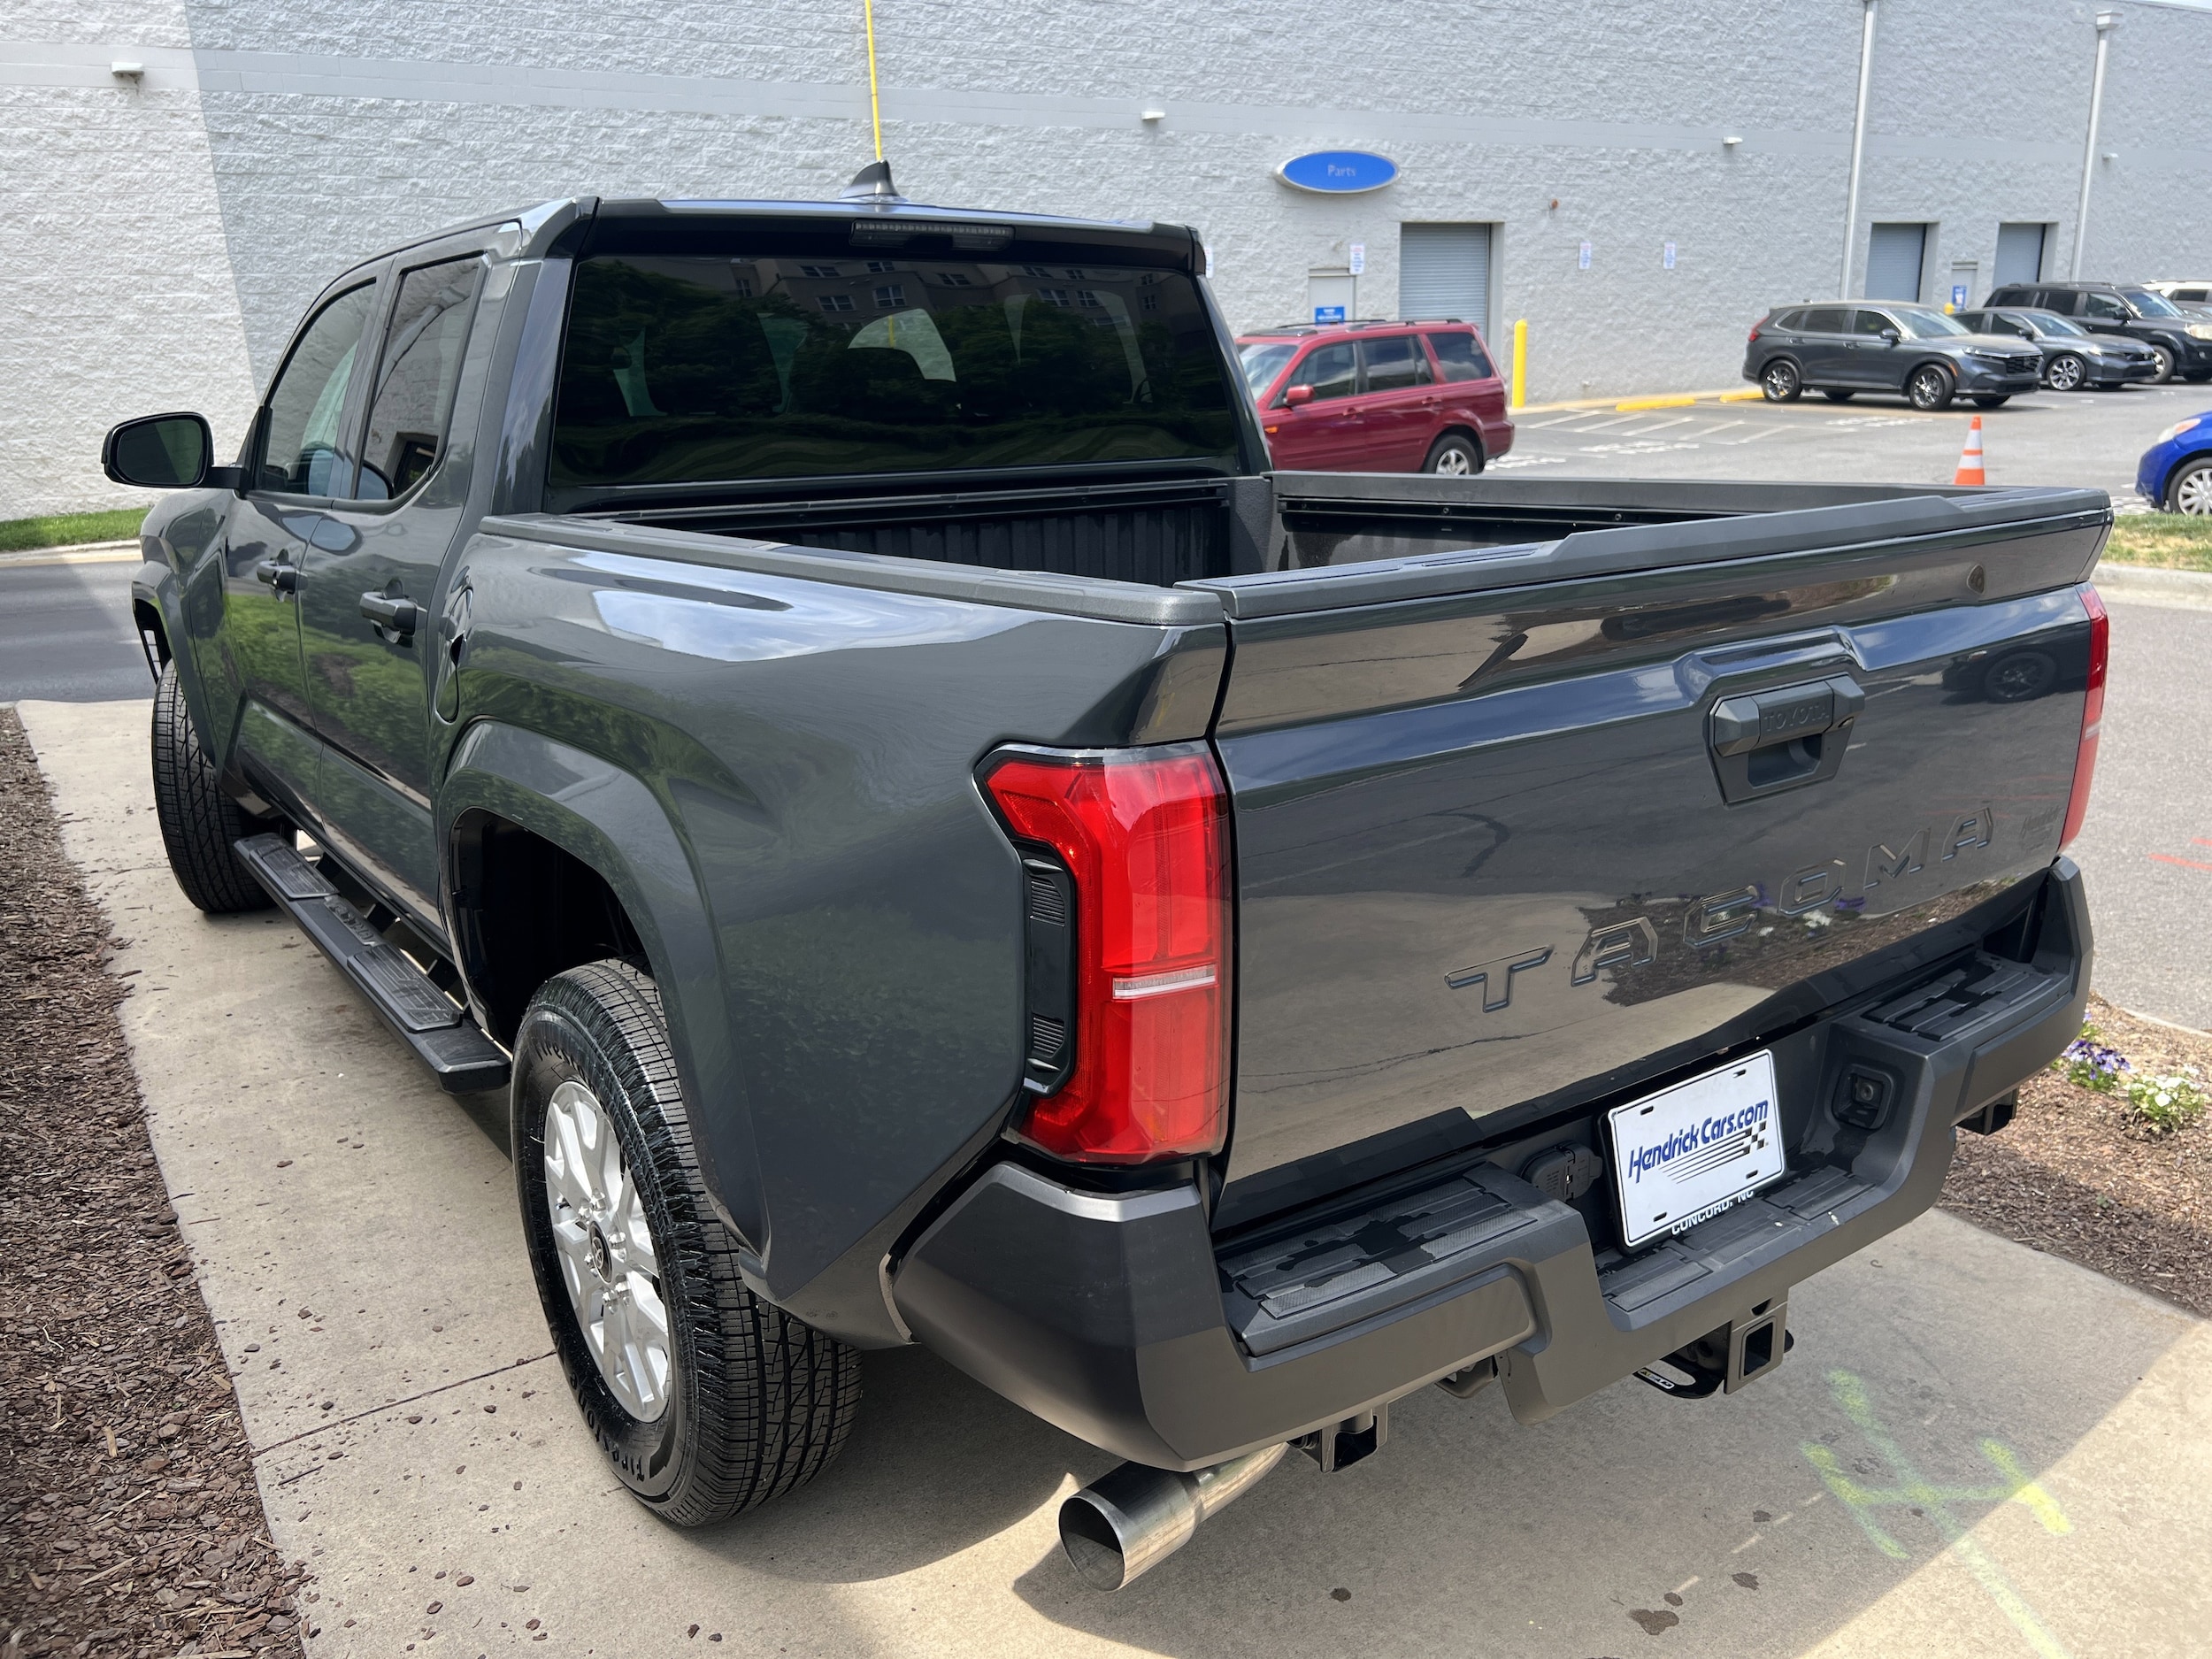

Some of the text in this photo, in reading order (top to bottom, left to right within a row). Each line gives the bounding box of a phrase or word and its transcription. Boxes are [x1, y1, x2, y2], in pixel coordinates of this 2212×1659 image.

[1327, 164, 1356, 177] Parts
[1764, 701, 1830, 732] TOYOTA
[1444, 806, 1993, 1013] TACOMA
